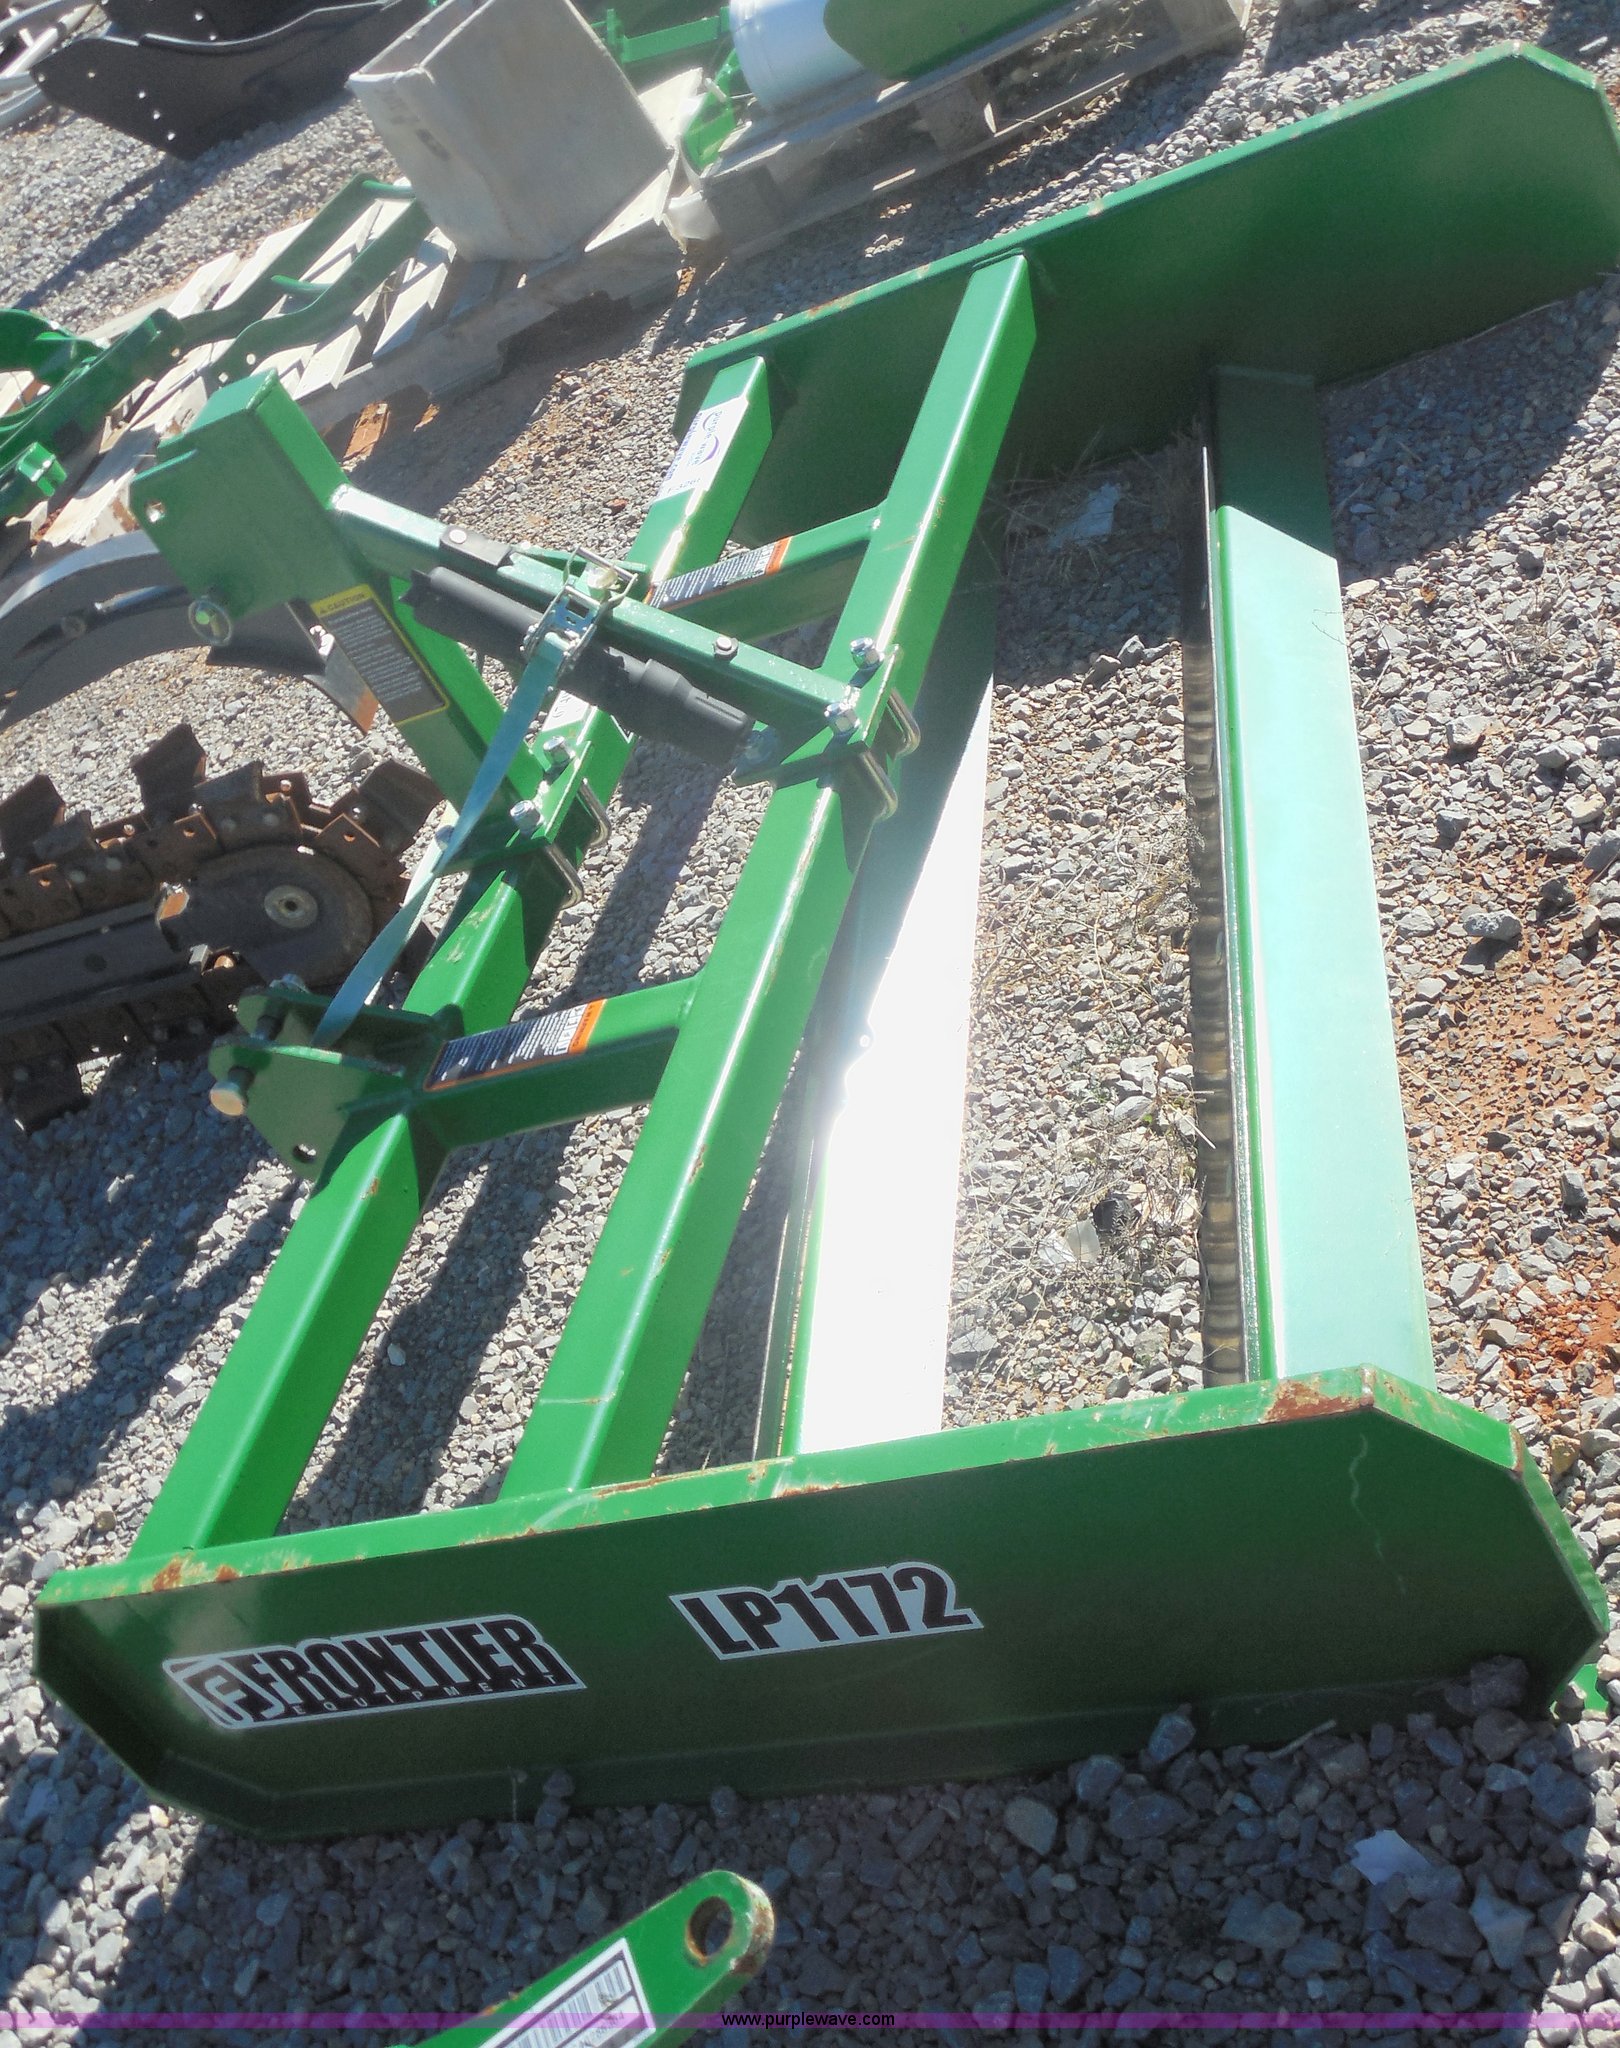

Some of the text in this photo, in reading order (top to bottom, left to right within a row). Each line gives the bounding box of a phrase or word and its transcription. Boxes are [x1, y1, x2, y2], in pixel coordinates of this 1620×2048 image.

[326, 591, 366, 611] CAUTION
[679, 1566, 974, 1655] LP1172
[218, 1618, 578, 1714] FRONTIER
[294, 1670, 560, 1716] EQUIPMENT
